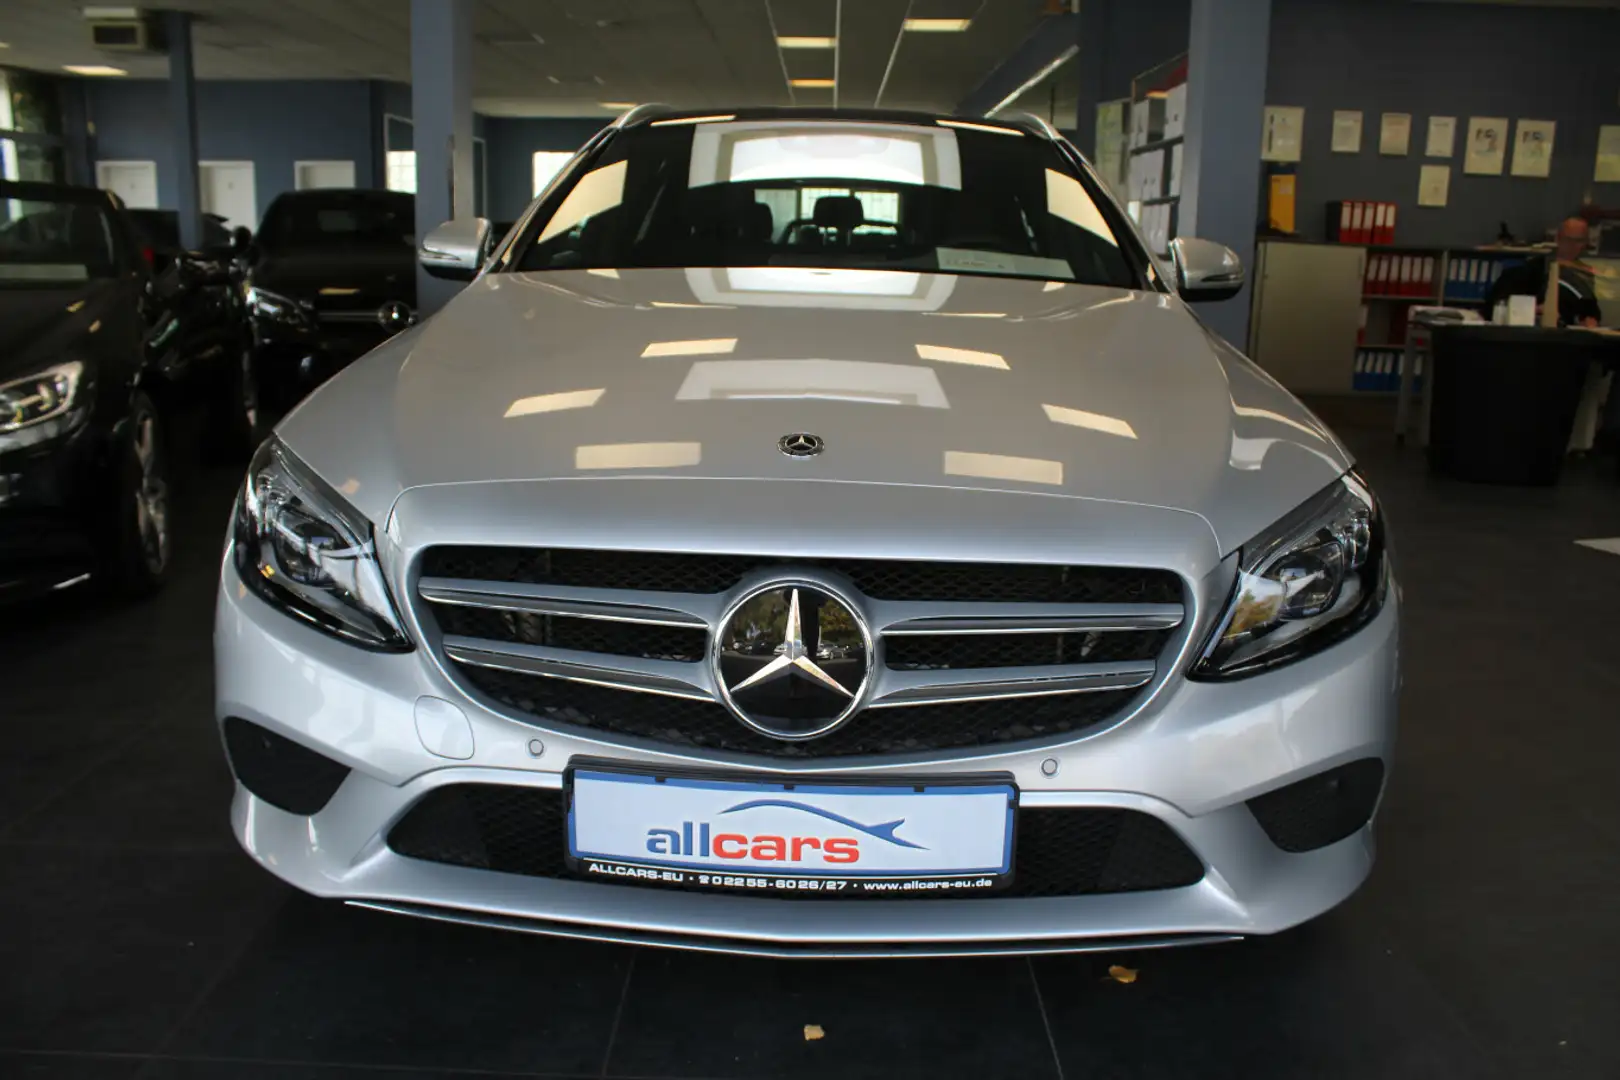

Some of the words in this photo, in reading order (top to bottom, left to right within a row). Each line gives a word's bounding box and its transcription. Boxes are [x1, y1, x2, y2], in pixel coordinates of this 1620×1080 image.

[646, 820, 860, 864] allcars
[588, 862, 684, 882] ALLCARS-EU
[863, 877, 993, 891] www.allcars-eu.de
